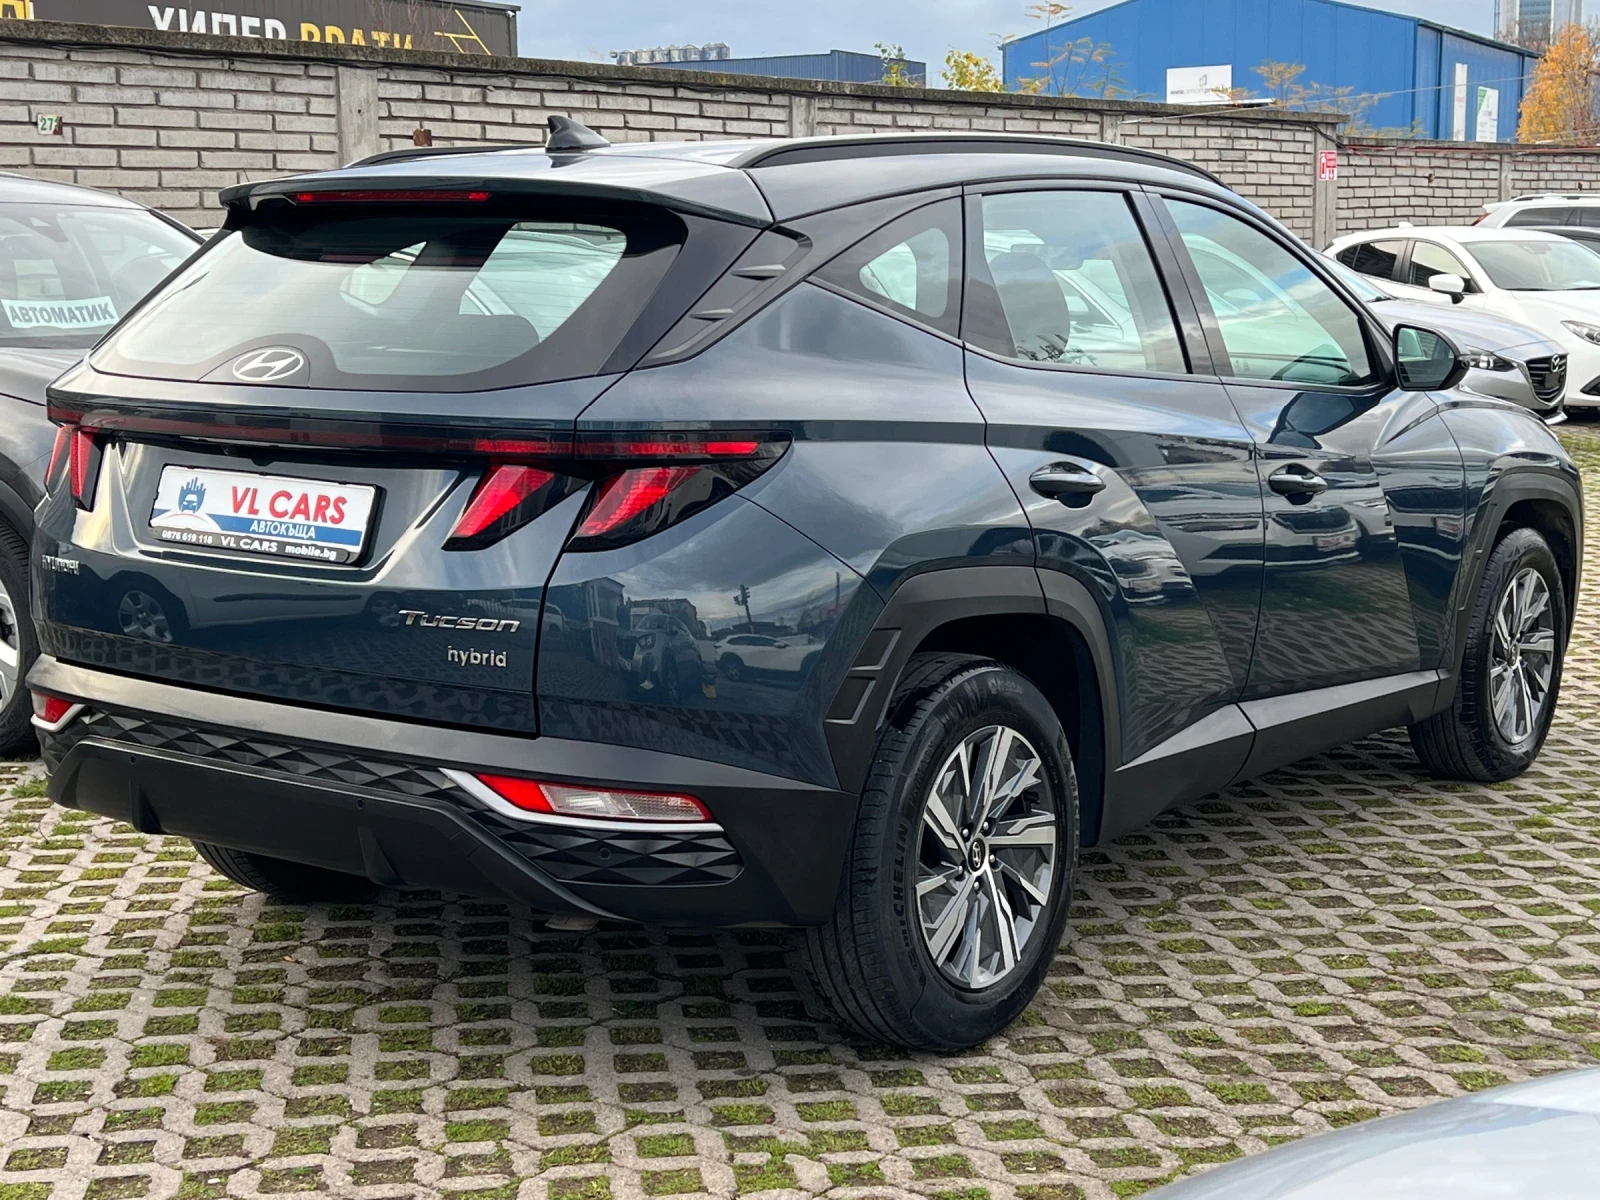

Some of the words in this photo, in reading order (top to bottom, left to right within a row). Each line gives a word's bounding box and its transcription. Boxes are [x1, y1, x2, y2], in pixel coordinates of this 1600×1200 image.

[9, 303, 115, 323] АВТОМАТИК
[231, 486, 260, 516] VL
[268, 490, 348, 525] CARS
[250, 521, 315, 539] АВТОКЪЩА
[198, 533, 213, 545] 118
[221, 536, 236, 547] VL
[240, 539, 278, 552] CARS
[285, 545, 337, 560] mobile.bg
[447, 645, 507, 667] hybrid
